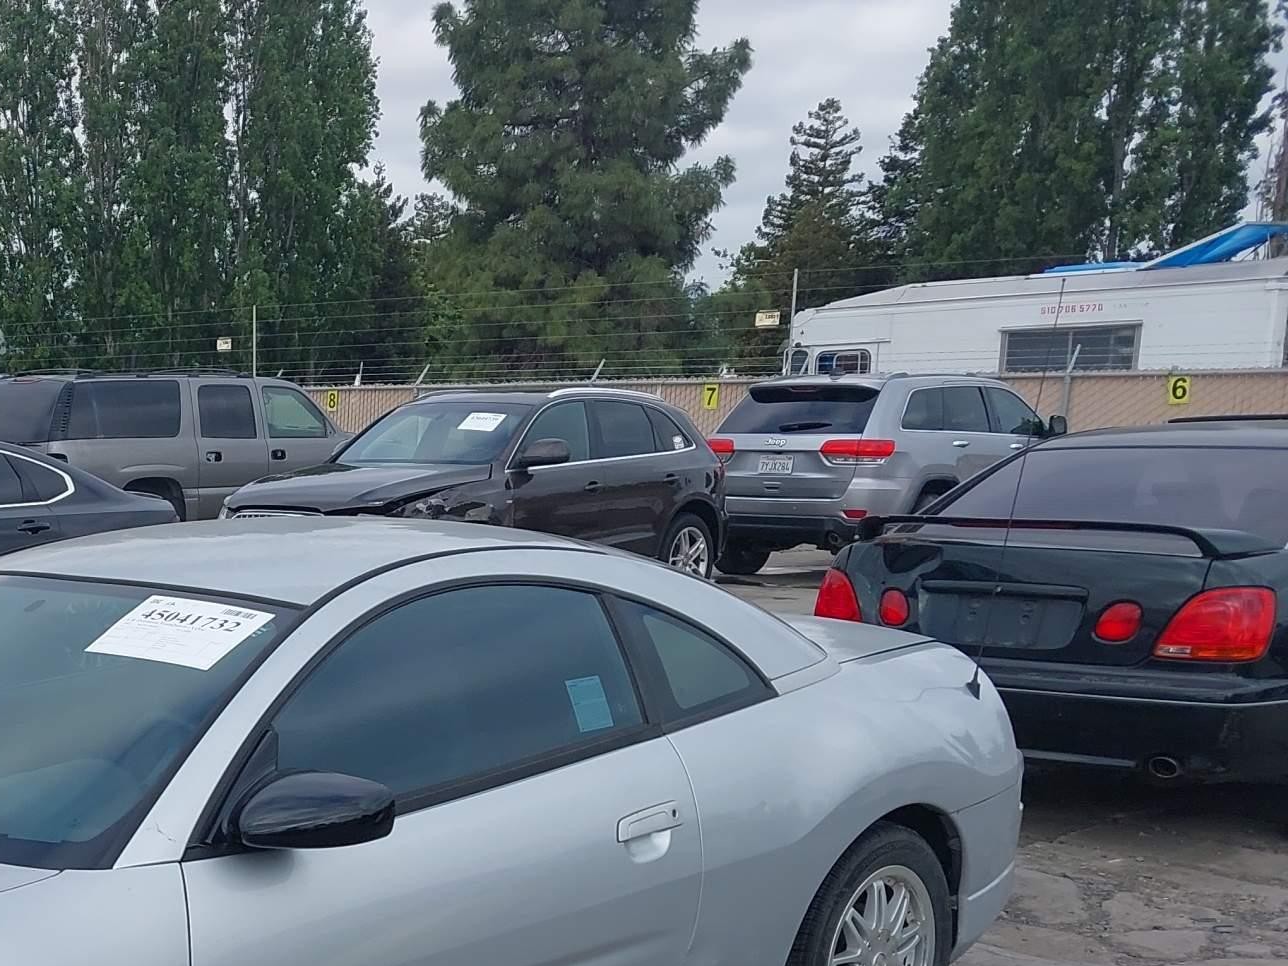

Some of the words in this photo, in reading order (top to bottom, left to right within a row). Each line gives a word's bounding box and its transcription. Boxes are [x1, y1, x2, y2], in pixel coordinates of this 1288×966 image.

[706, 387, 716, 405] 7
[1172, 377, 1187, 400] 6
[329, 393, 336, 408] 8
[764, 437, 786, 447] Jeep
[141, 608, 242, 633] 45041732
